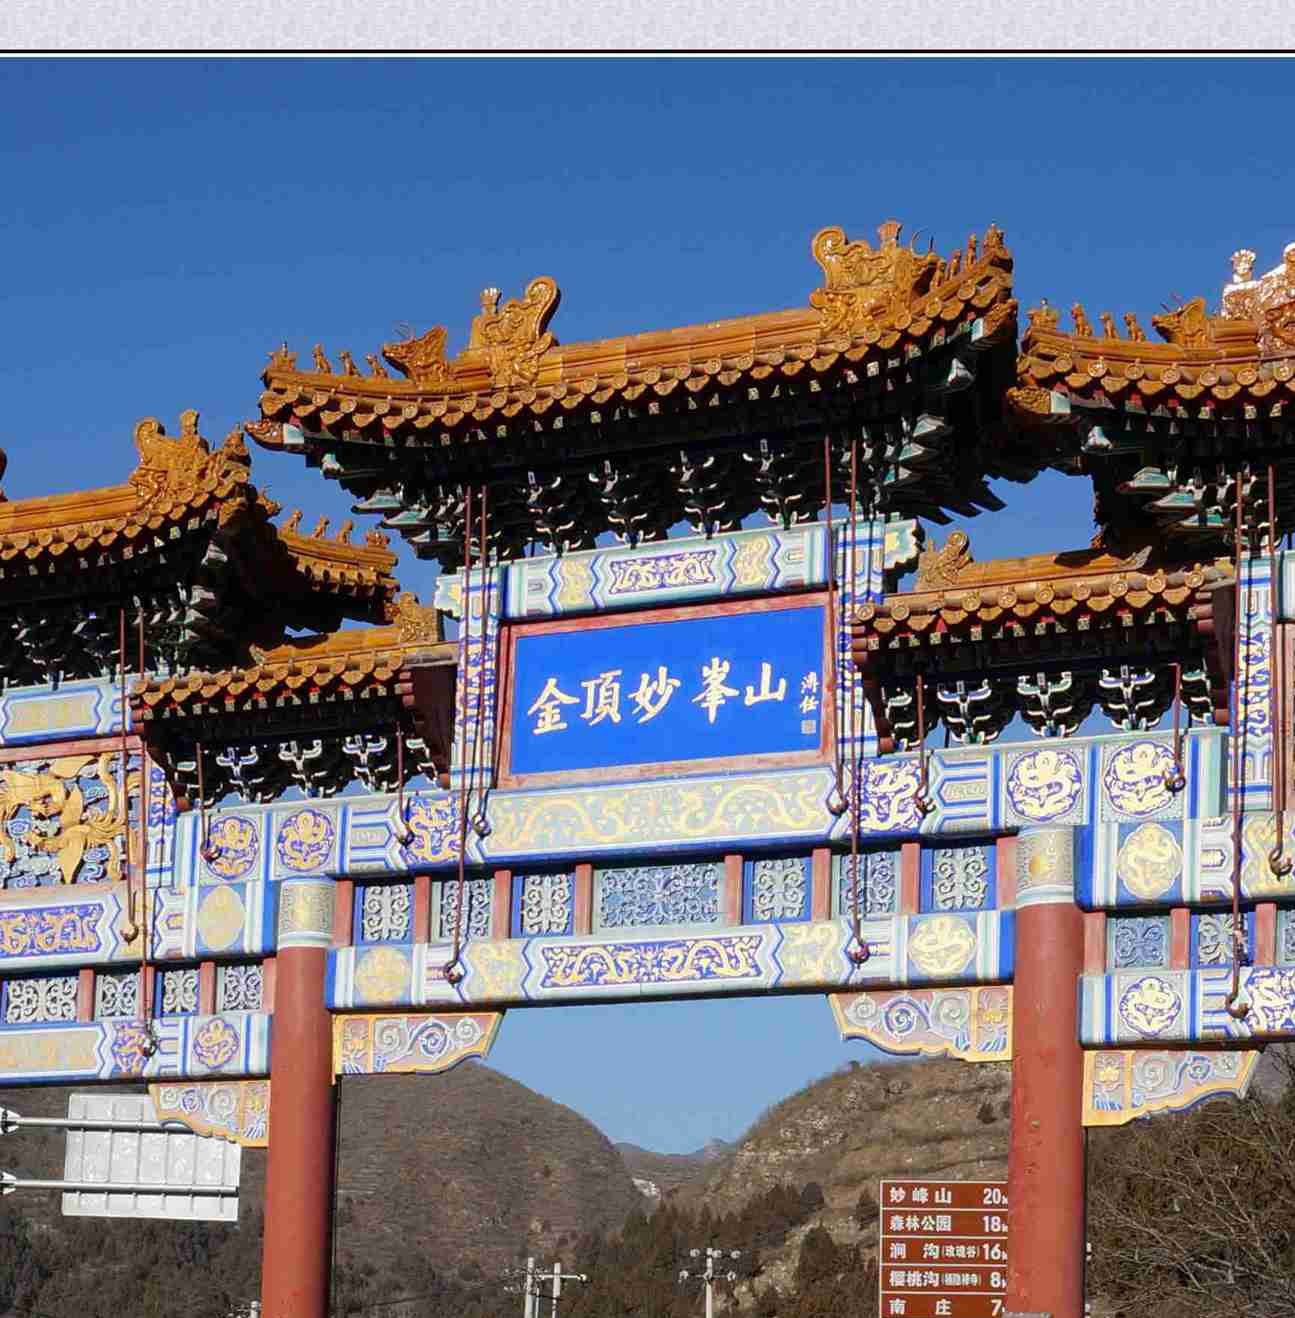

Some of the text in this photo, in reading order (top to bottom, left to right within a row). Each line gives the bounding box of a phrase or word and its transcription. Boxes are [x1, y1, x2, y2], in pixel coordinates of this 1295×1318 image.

[889, 1187, 952, 1204] 妙峰山
[889, 1215, 952, 1232] 森林公园
[889, 1299, 1006, 1316] 南庄 7
